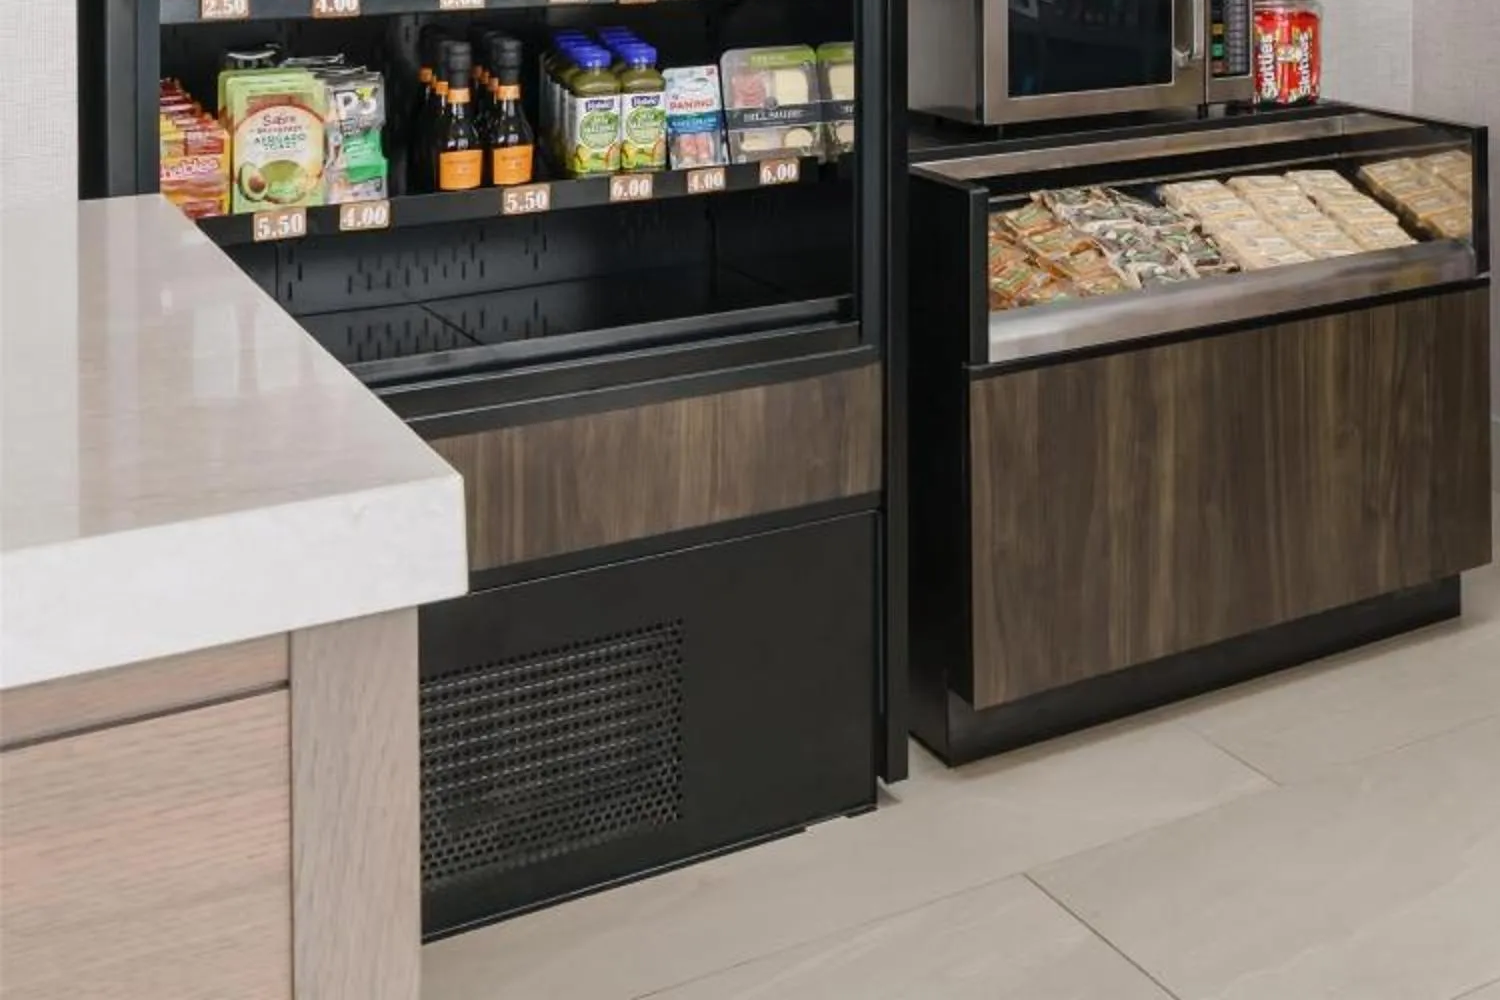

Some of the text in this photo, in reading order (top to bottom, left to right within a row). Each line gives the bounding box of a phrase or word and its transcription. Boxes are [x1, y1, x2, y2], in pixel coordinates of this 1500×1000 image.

[762, 163, 797, 181] 6.00
[506, 190, 548, 211] 5.50
[257, 212, 304, 237] 5.50
[343, 207, 386, 227] 4.00
